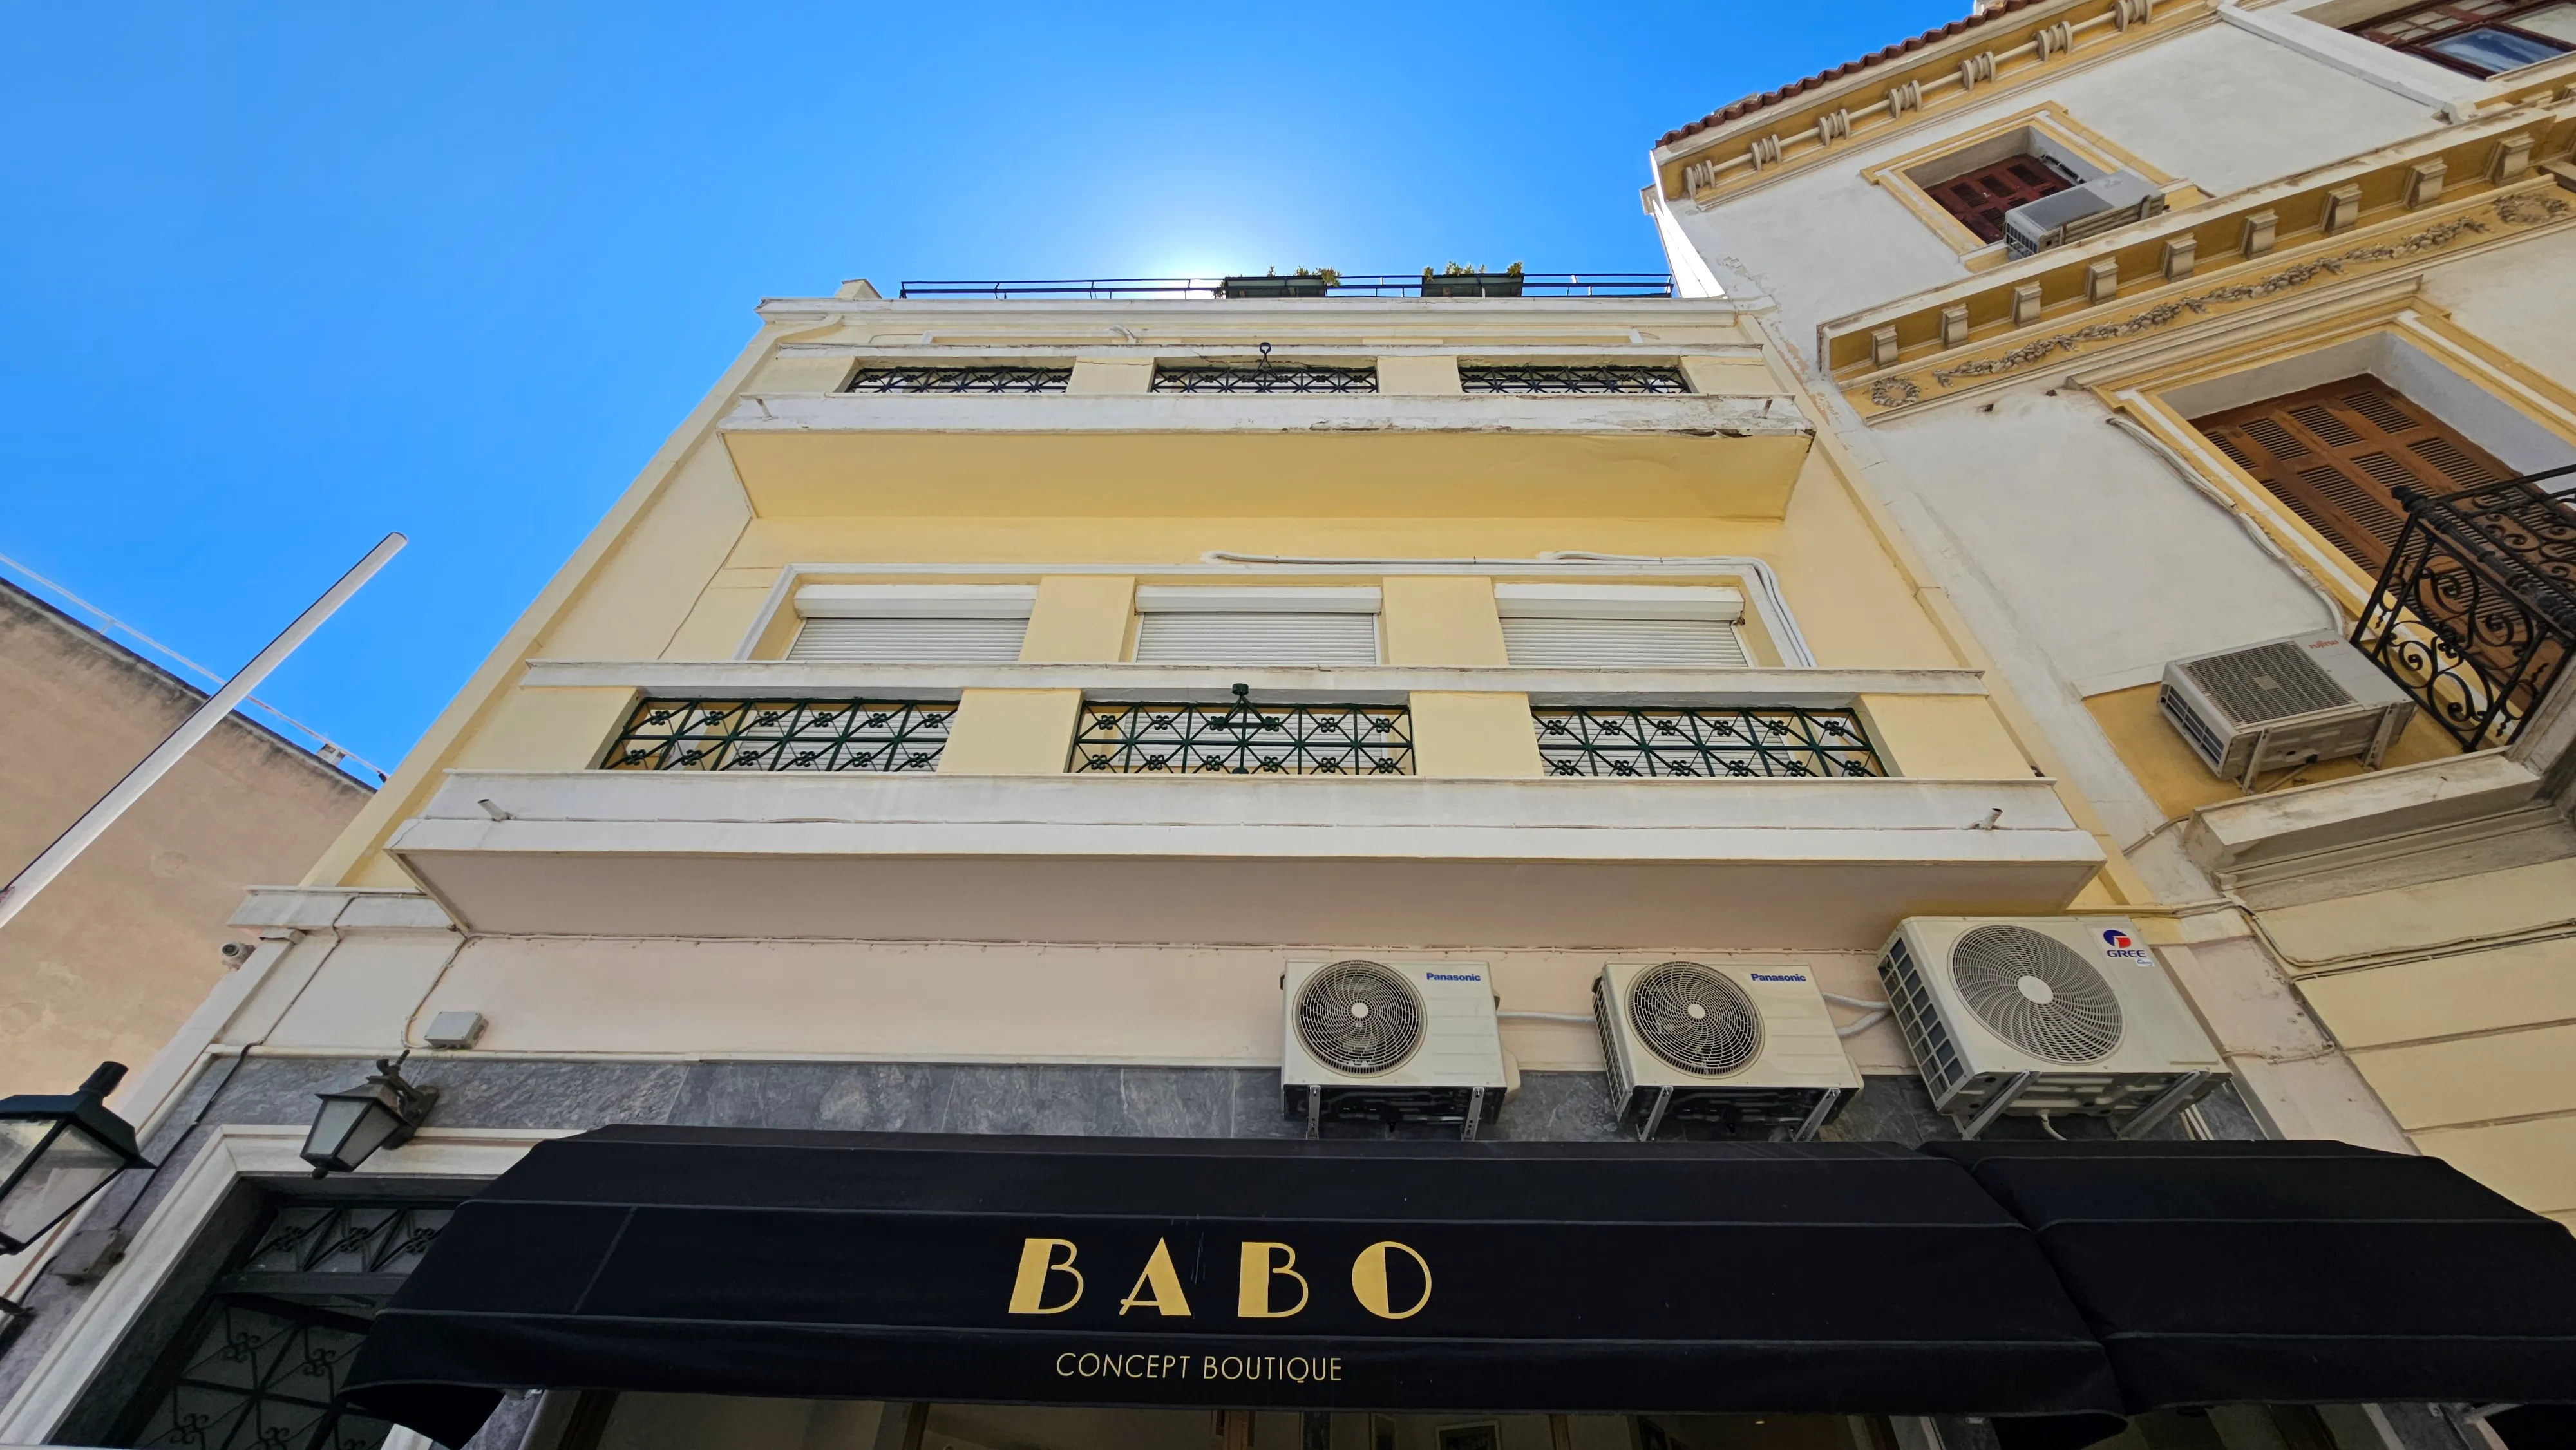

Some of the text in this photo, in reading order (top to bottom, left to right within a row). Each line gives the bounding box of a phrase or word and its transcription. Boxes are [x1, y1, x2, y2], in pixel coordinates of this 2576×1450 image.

[2107, 950, 2147, 958] GREE
[1426, 972, 1481, 981] Panasonic
[1750, 973, 1807, 981] Panasonic
[1009, 1238, 1430, 1319] BABO
[1056, 1353, 1341, 1383] CONCEPT BOUTIQUE
